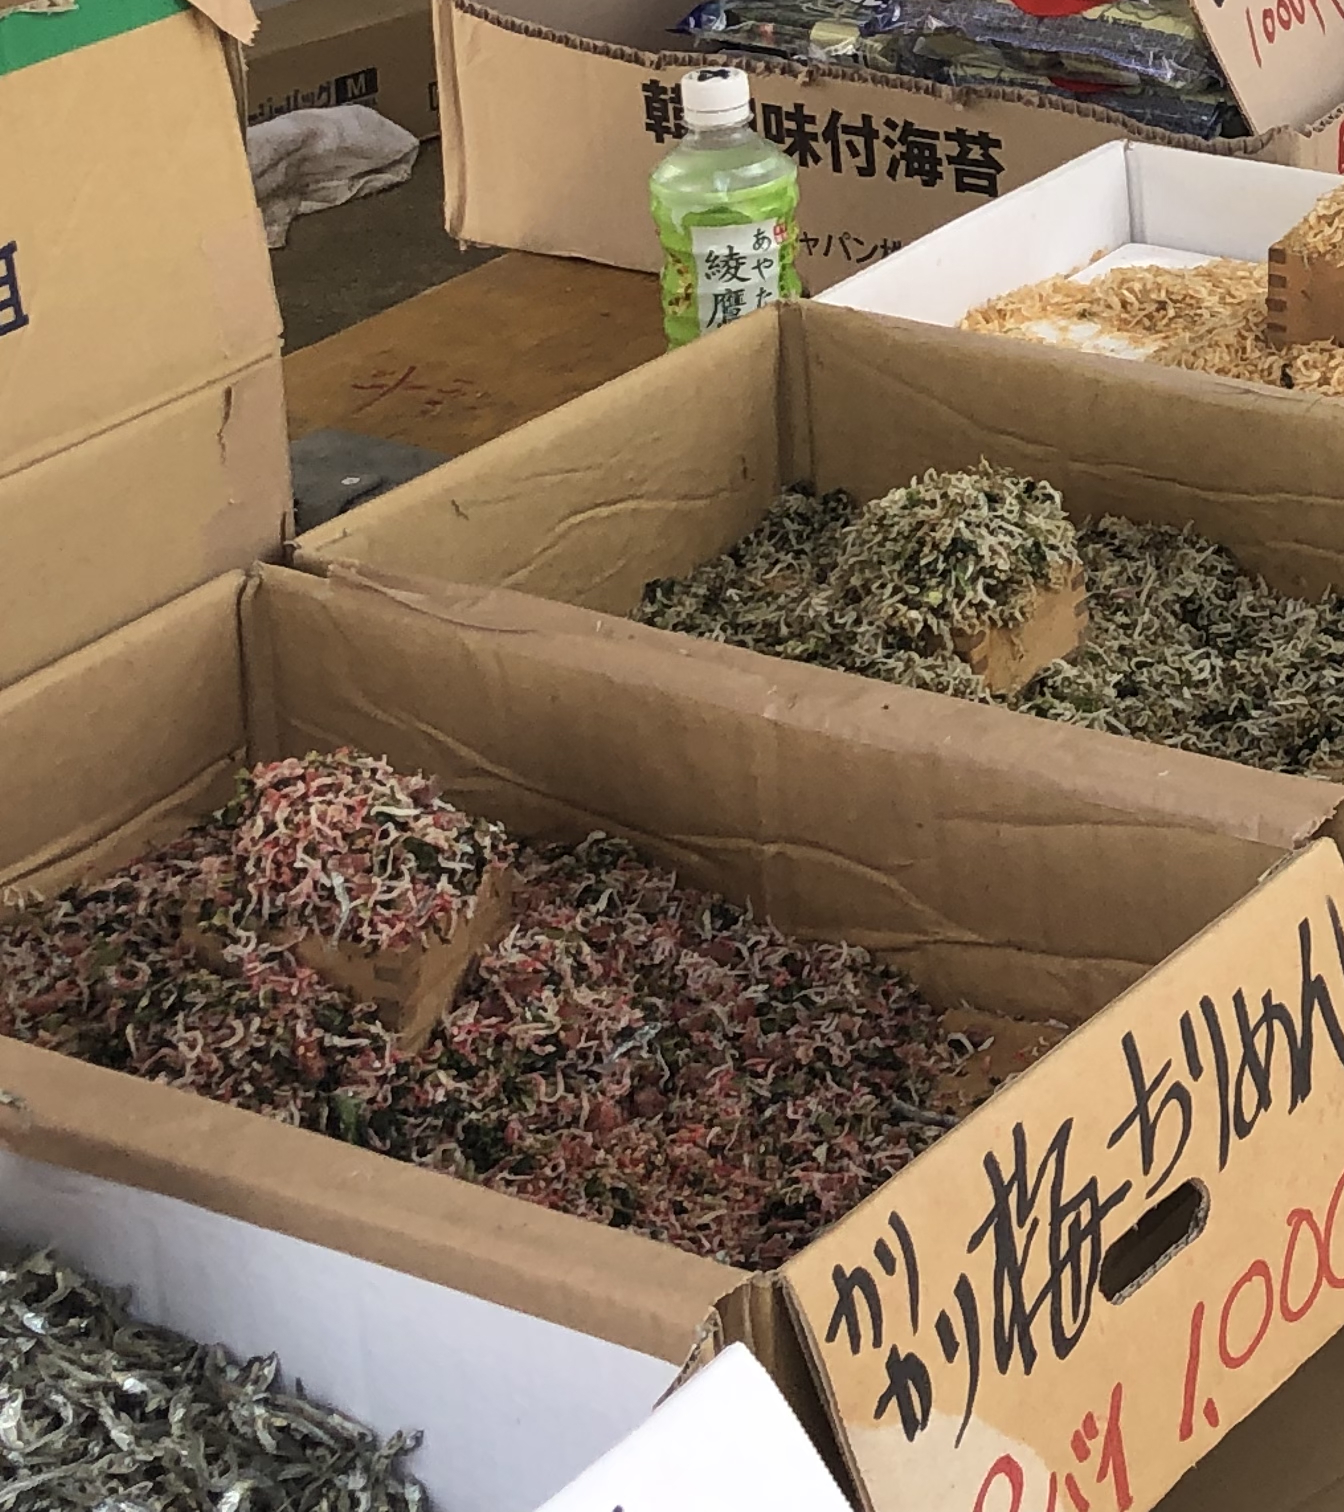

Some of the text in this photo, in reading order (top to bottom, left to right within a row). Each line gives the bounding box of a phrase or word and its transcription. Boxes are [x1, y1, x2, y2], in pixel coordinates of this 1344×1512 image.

[640, 77, 1006, 198] 韓味付海苔
